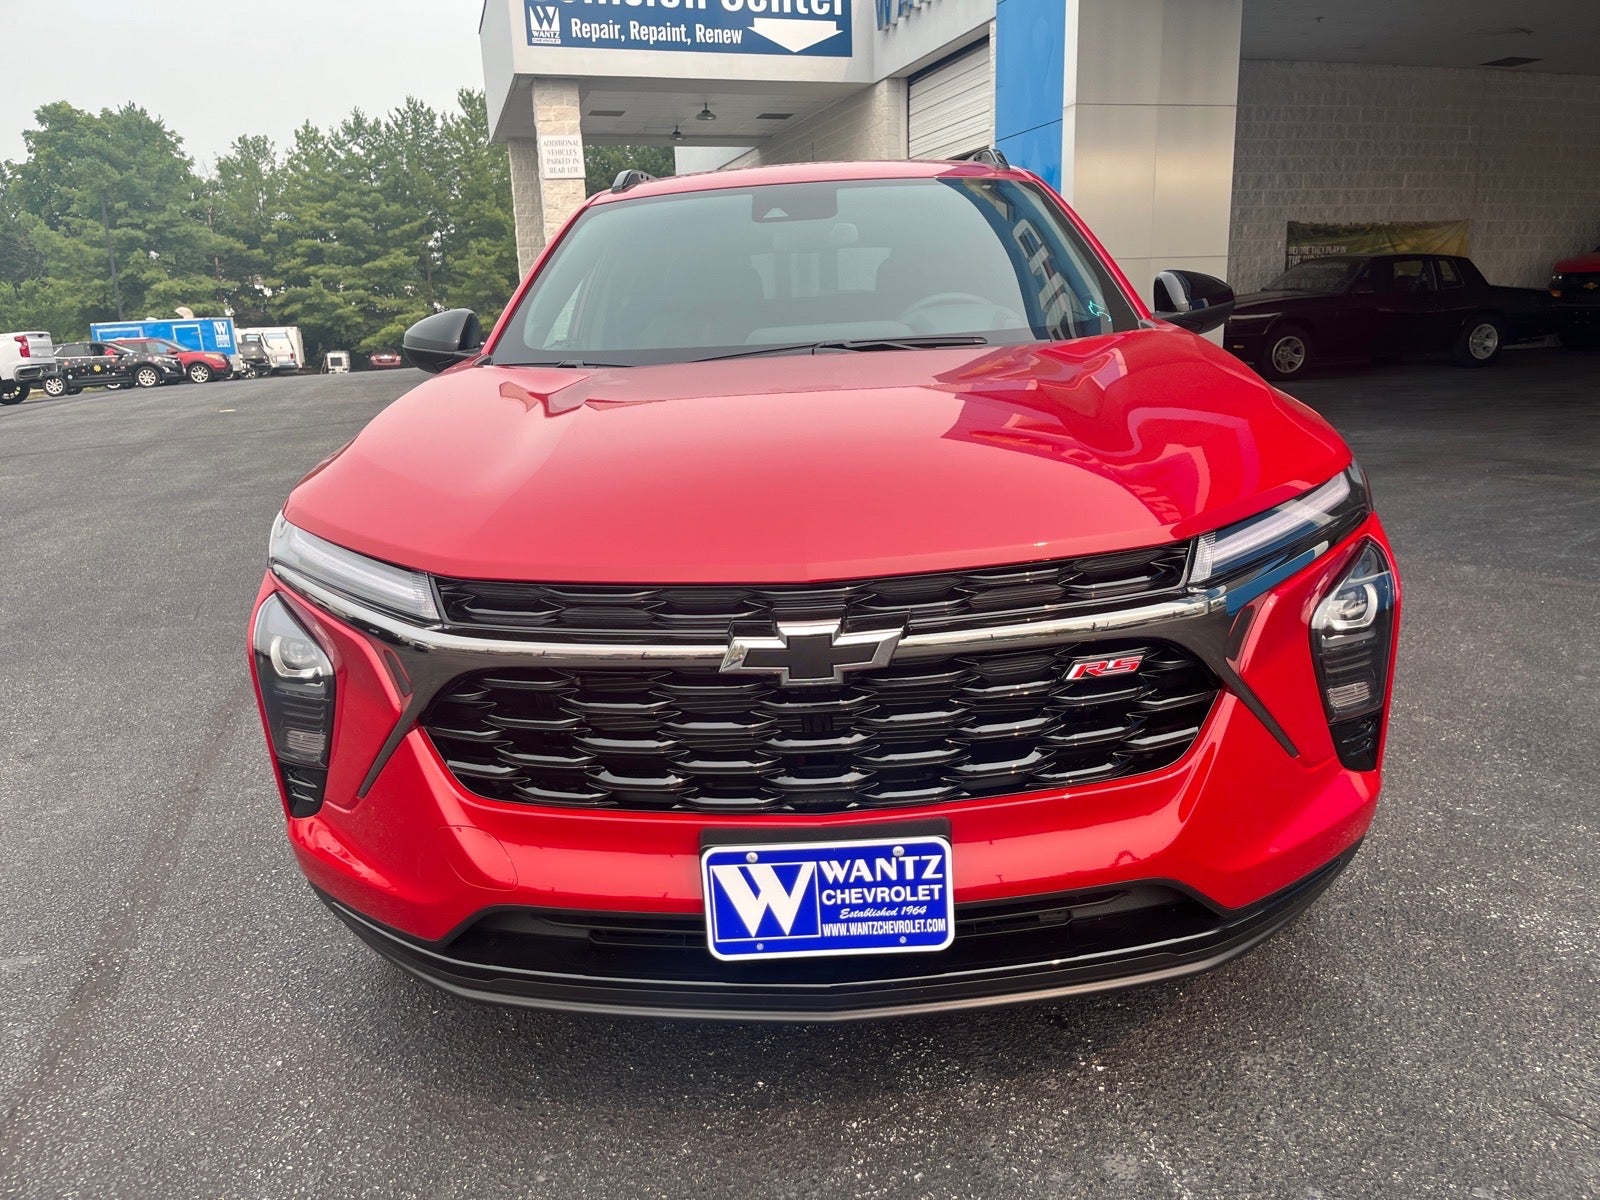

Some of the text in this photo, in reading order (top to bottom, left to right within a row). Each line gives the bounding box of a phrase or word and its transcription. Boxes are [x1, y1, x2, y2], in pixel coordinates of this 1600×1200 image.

[532, 30, 560, 39] WANTZ
[571, 18, 743, 45] Repair, Repaint, Renew
[543, 139, 579, 147] ADDITIONAL
[1065, 655, 1144, 680] RS
[819, 854, 943, 885] WANTZ
[821, 884, 943, 906] CHEVROLET
[839, 905, 927, 919] Established 1964
[822, 918, 946, 937] WWW.WANTZCHEVROLET.COM
